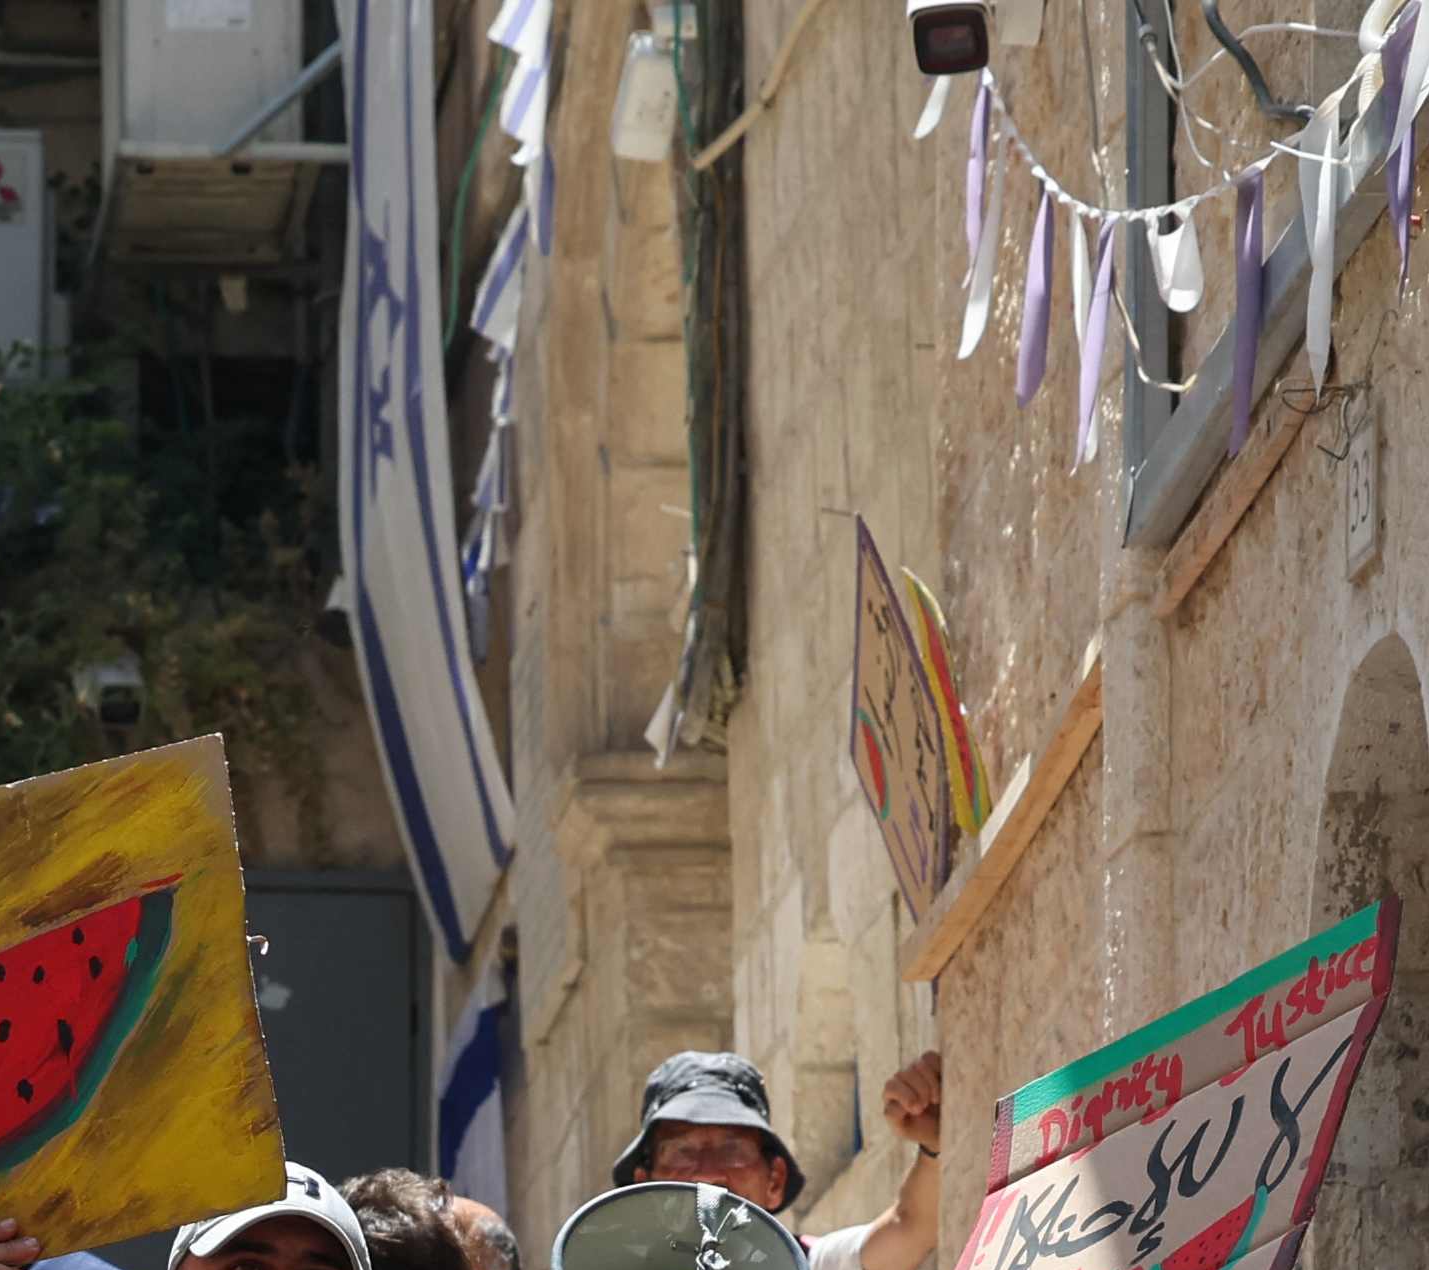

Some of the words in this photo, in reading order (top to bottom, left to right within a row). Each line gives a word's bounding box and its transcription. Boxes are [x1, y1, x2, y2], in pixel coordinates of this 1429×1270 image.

[1350, 450, 1371, 533] 33
[1035, 1053, 1183, 1170] Dignity
[1219, 932, 1380, 1087] Justice
